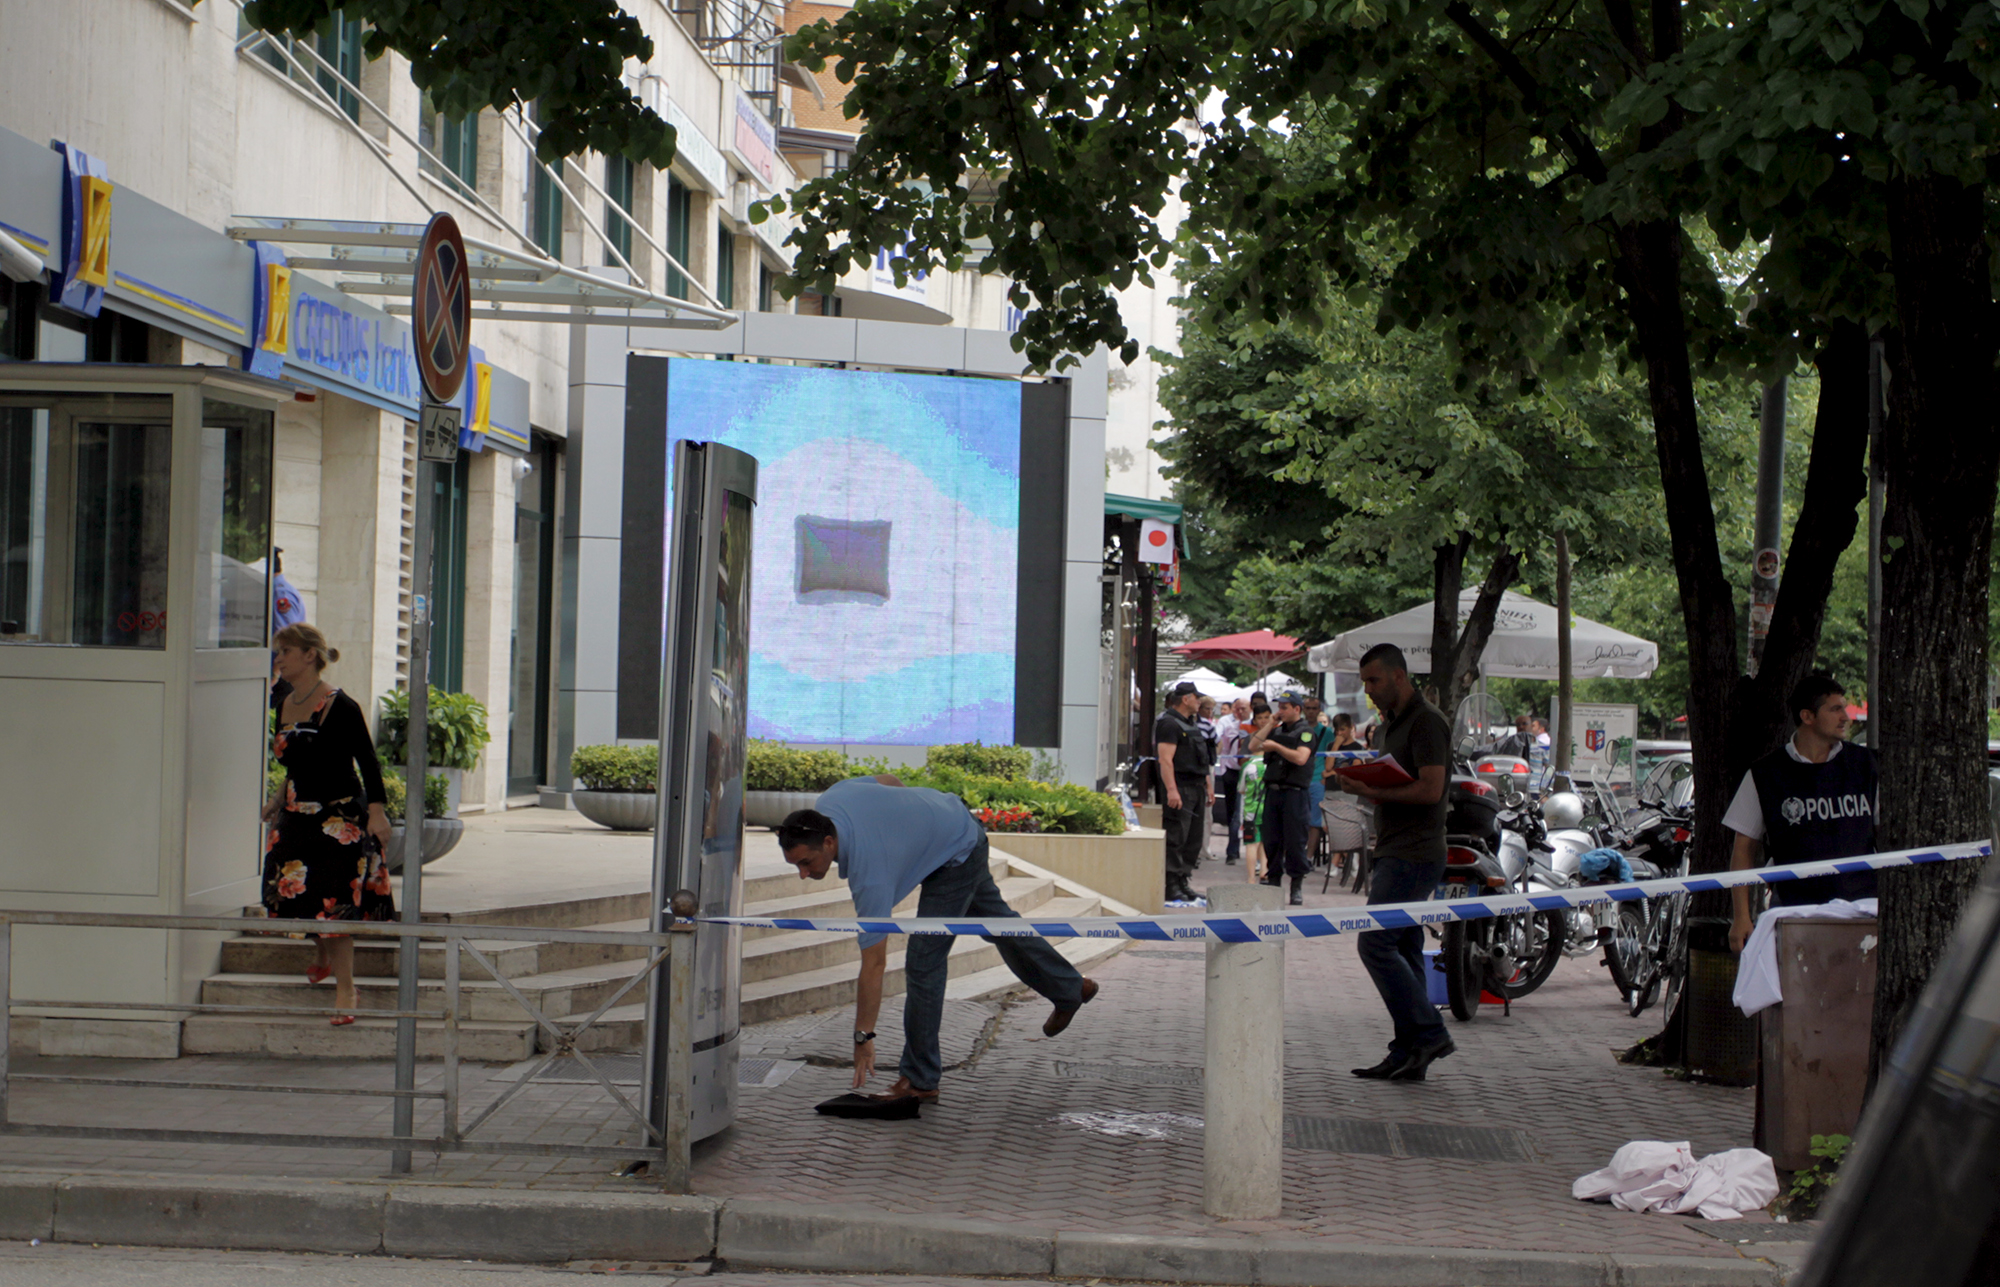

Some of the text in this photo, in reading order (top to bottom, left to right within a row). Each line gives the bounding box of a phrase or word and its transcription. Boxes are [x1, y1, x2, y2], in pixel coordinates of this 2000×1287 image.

[294, 292, 411, 399] CREDINS bank
[1805, 793, 1872, 821] POLICIA
[1173, 927, 1206, 938] POLICIA
[1258, 924, 1291, 936] POLICIA
[1340, 918, 1371, 930] POLICIA
[1420, 912, 1452, 923] POLICIA
